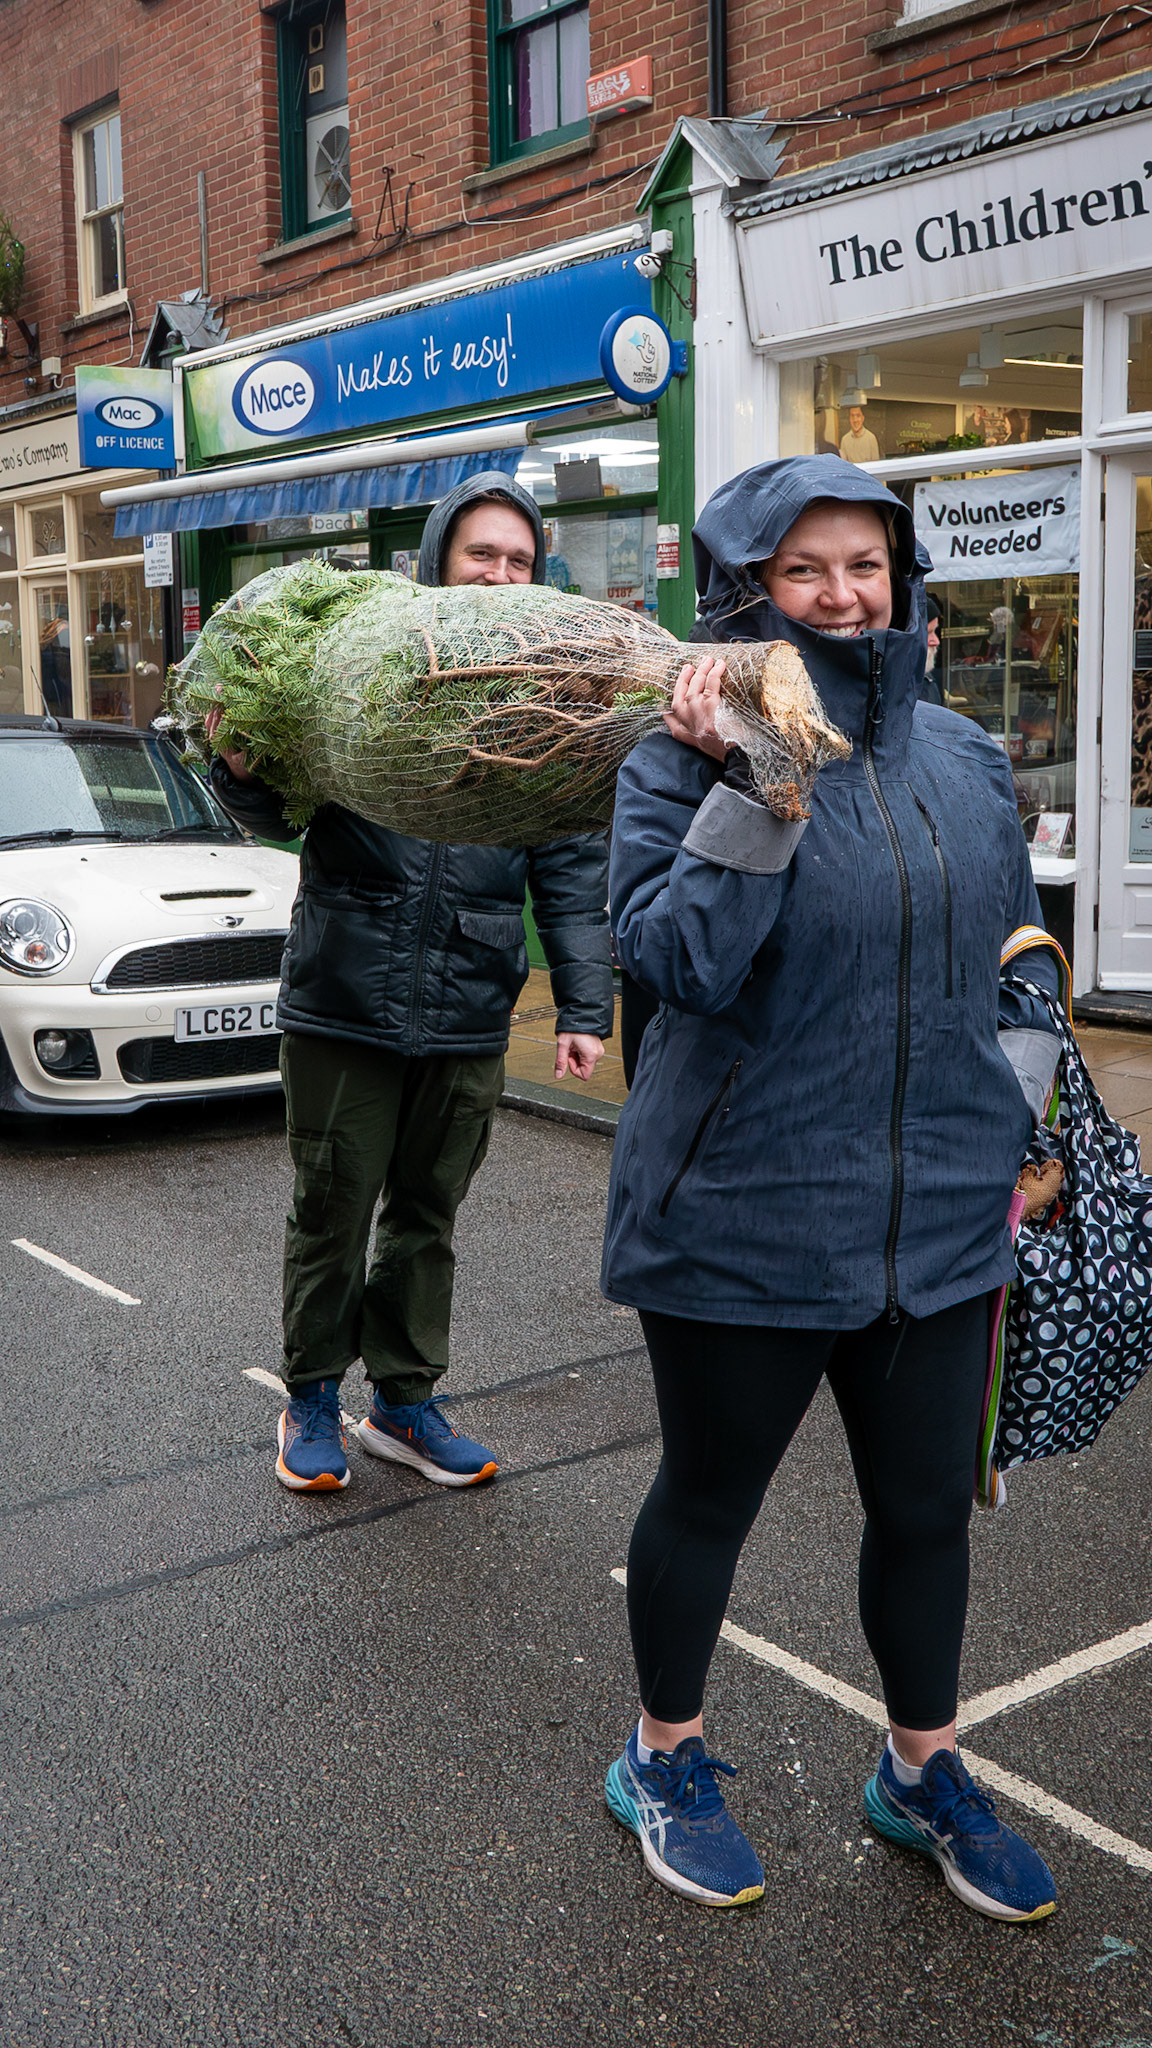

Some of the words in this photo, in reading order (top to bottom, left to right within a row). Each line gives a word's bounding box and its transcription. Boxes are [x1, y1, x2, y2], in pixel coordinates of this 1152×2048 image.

[588, 71, 628, 94] EAGLE
[820, 234, 904, 285] The
[337, 350, 412, 403] Makes
[422, 335, 444, 380] it
[451, 312, 517, 388] easy!
[633, 371, 658, 379] NATIONAL
[250, 381, 306, 415] Mace
[109, 406, 141, 421] Mac
[96, 436, 116, 448] OFF
[119, 436, 164, 450] LICENCE
[1045, 428, 1066, 436] Increase
[0, 448, 23, 473] wo's
[23, 442, 69, 466] Company
[928, 496, 1066, 527] Volunteers
[658, 544, 678, 553] Alarm
[950, 525, 1042, 558] Needed
[607, 587, 632, 598] U18?
[183, 608, 200, 617] Alarm
[186, 1006, 252, 1036] LC62
[260, 1004, 274, 1029] C
